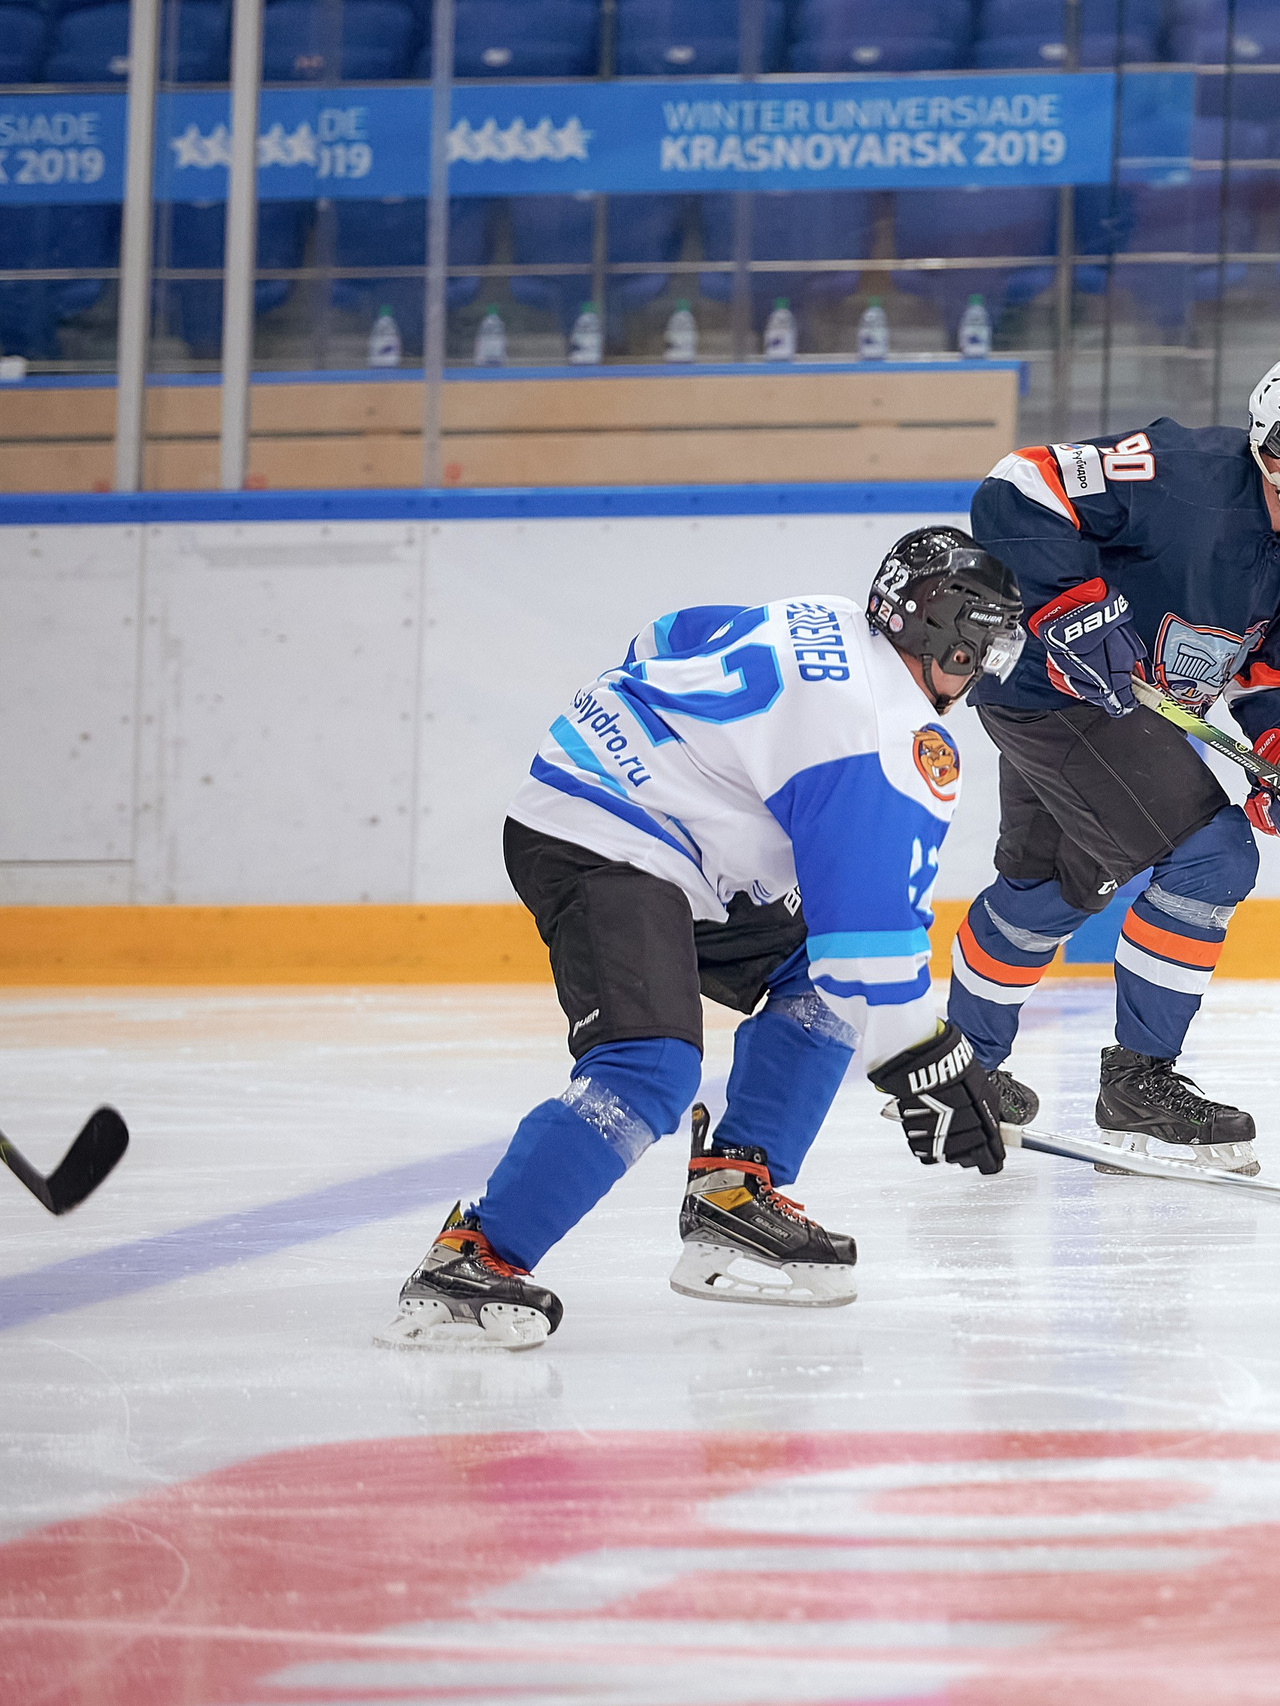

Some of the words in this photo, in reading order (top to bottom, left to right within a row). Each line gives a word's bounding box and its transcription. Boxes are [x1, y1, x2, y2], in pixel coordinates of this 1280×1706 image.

[661, 100, 809, 132] WINTER
[814, 94, 1063, 130] UNIVERSIADE
[15, 148, 105, 185] 2019
[659, 132, 968, 172] KRASNOYARSK
[973, 130, 1067, 168] 2019
[877, 558, 909, 603] 22
[970, 611, 1003, 627] BAUER
[1210, 740, 1260, 773] WARRIOR
